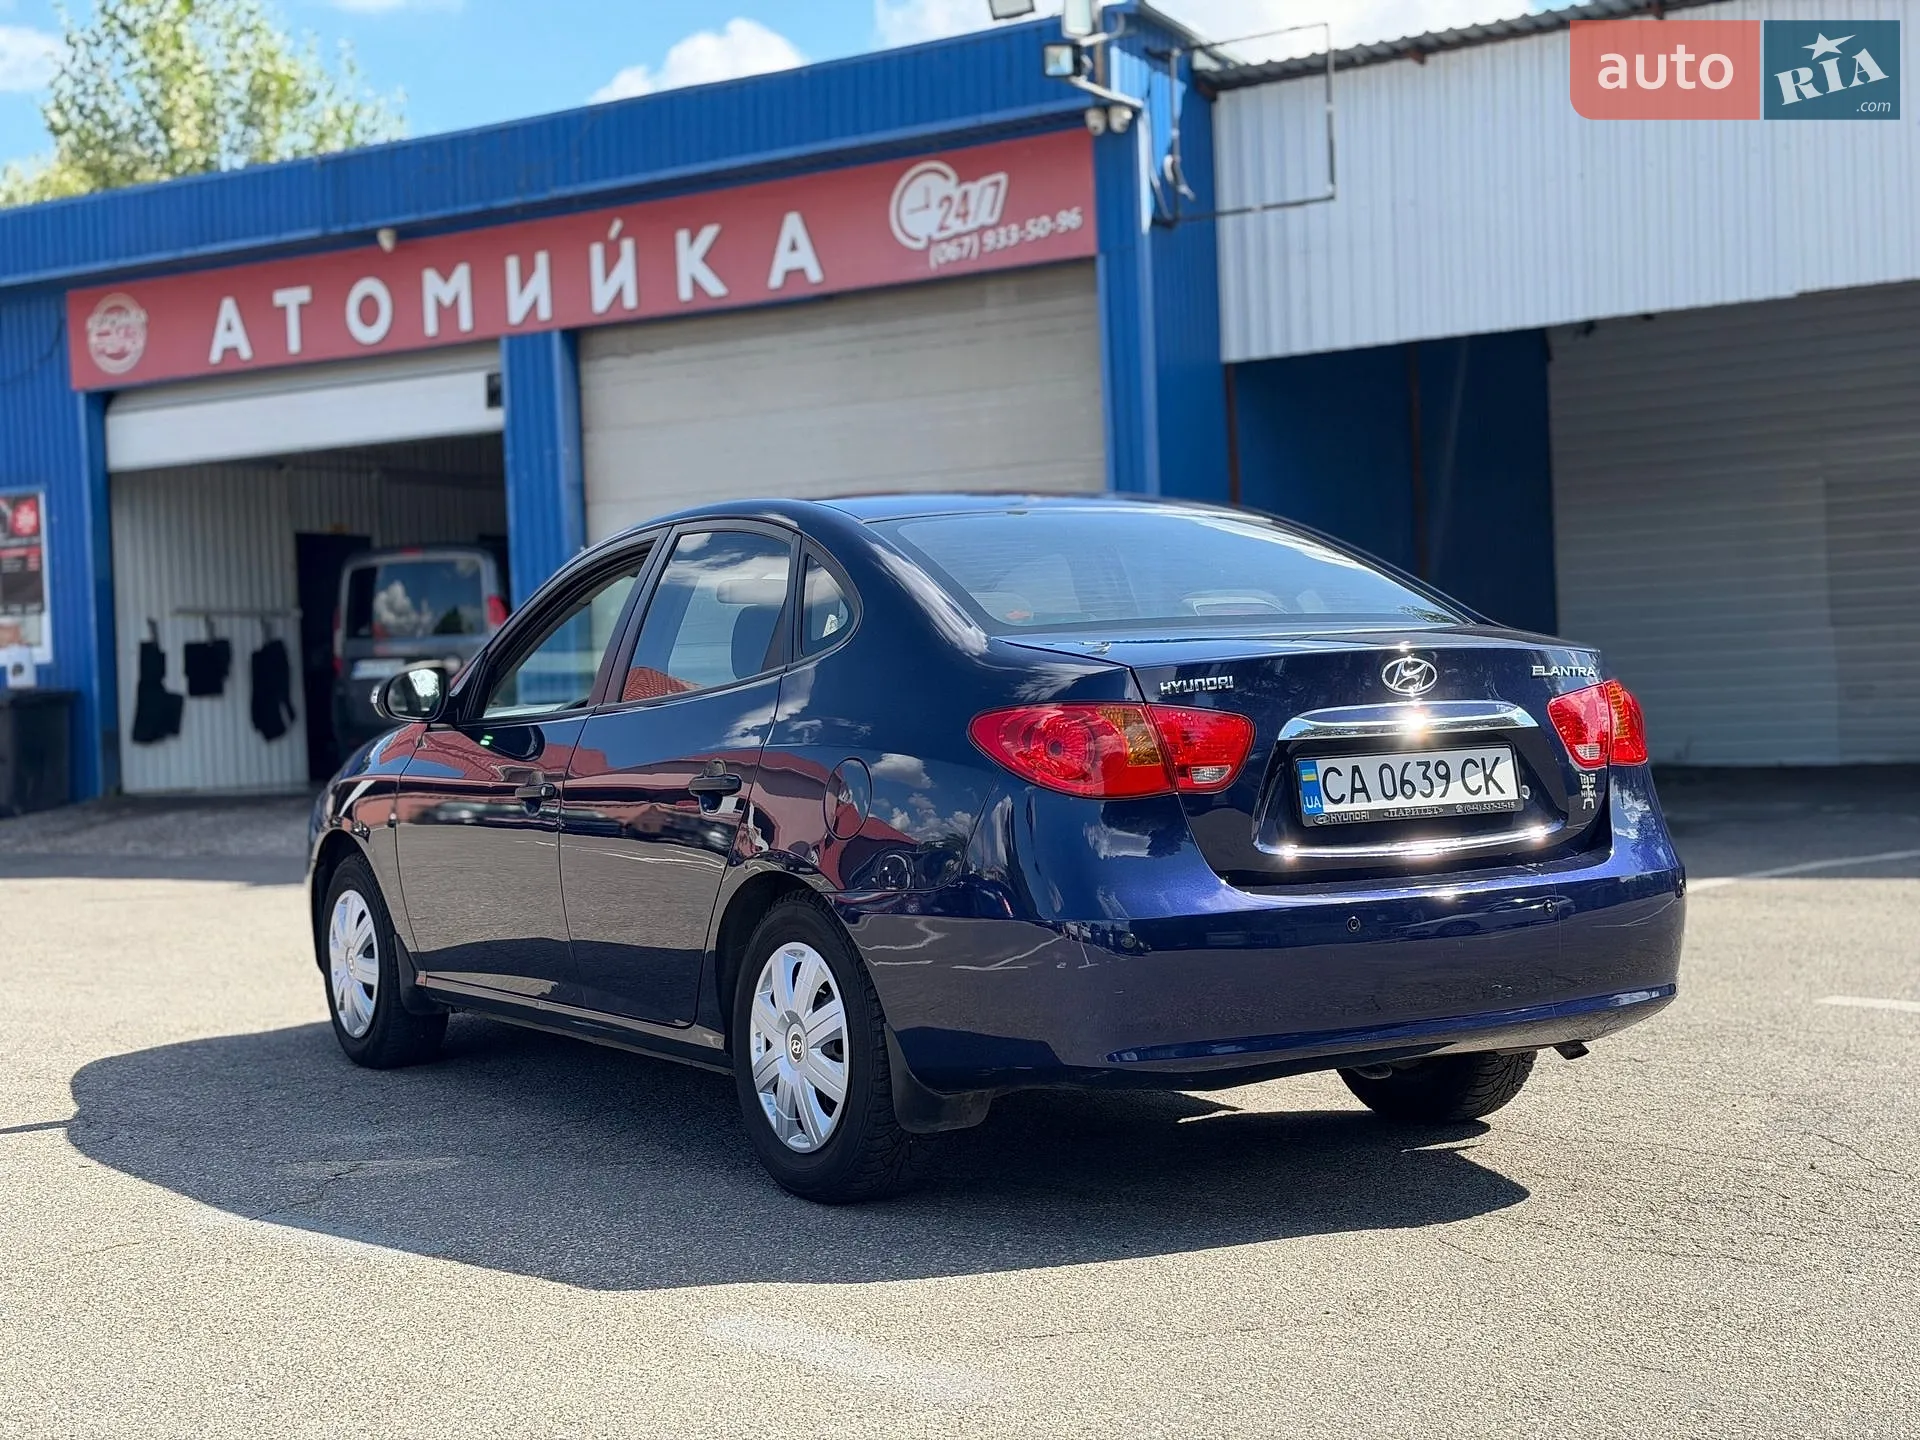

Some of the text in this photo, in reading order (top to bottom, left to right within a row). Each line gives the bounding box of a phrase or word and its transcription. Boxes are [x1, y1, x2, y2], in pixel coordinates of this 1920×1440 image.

[929, 206, 1084, 270] (067) 933-50-96
[1532, 665, 1597, 677] ELANTRA
[1159, 675, 1234, 695] HYUNDAI
[1305, 756, 1506, 808] UA CA 0639 CK
[1329, 811, 1370, 823] HYUNDAI
